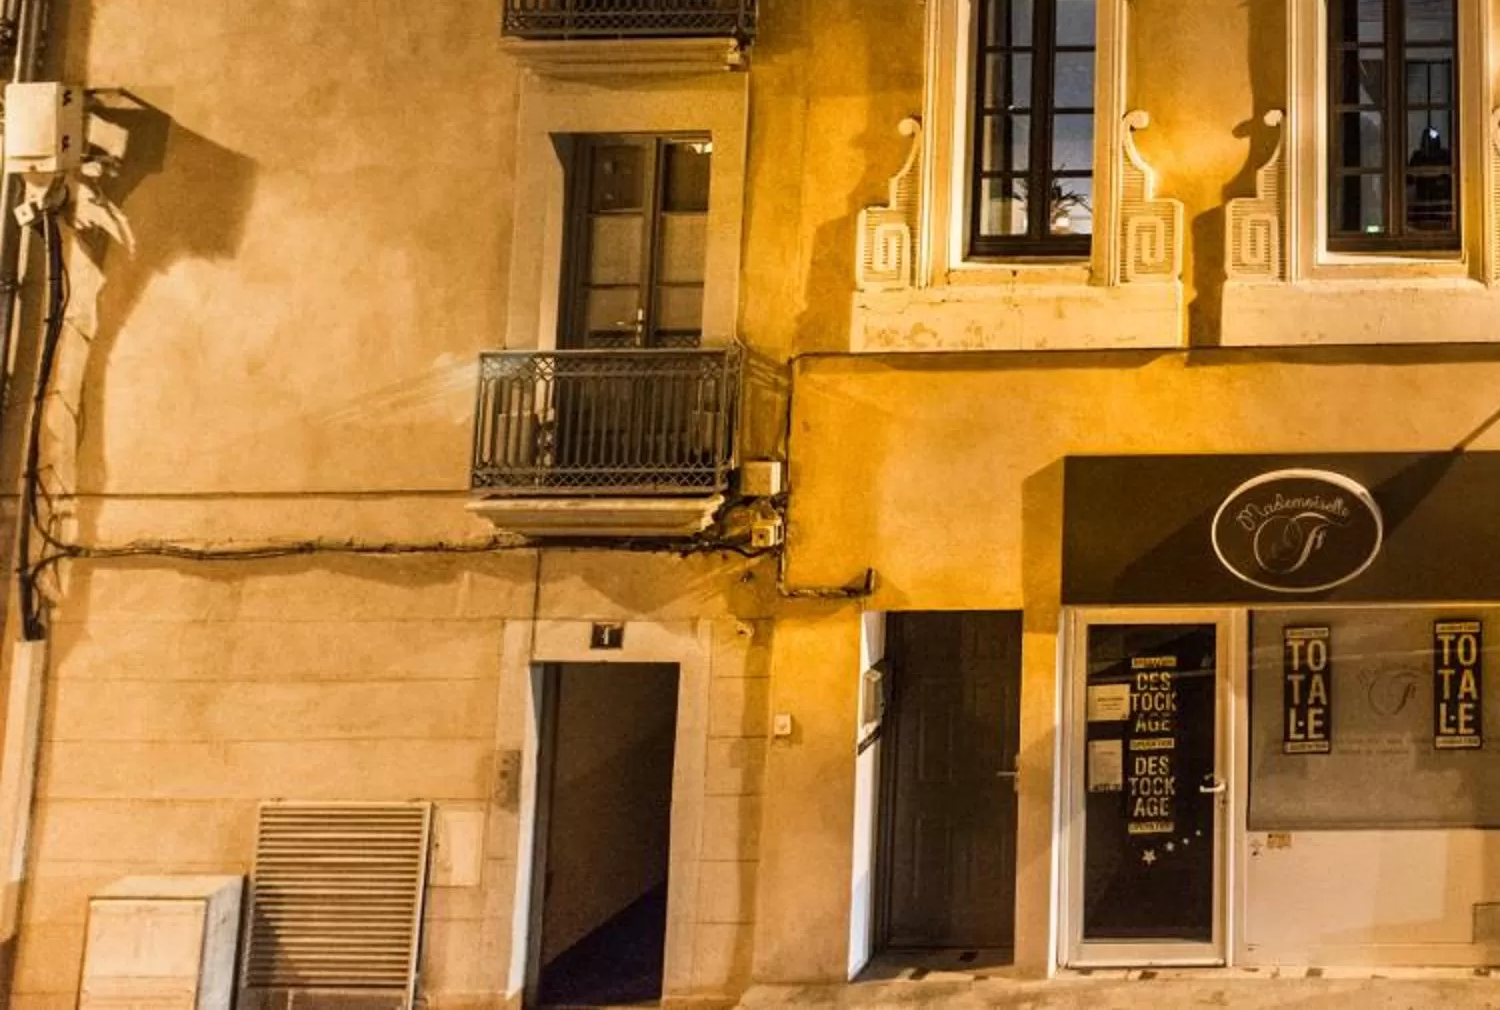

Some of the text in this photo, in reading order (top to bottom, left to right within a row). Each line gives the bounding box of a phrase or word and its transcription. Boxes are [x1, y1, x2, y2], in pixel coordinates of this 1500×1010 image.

[1286, 639, 1327, 671] TO
[1436, 634, 1477, 665] TO
[1287, 674, 1327, 705] TA
[1438, 669, 1478, 700] TA
[1131, 692, 1177, 712] TOCK
[1135, 756, 1169, 775] DES
[1128, 776, 1175, 796] TOCK
[1133, 797, 1169, 817] AGE
